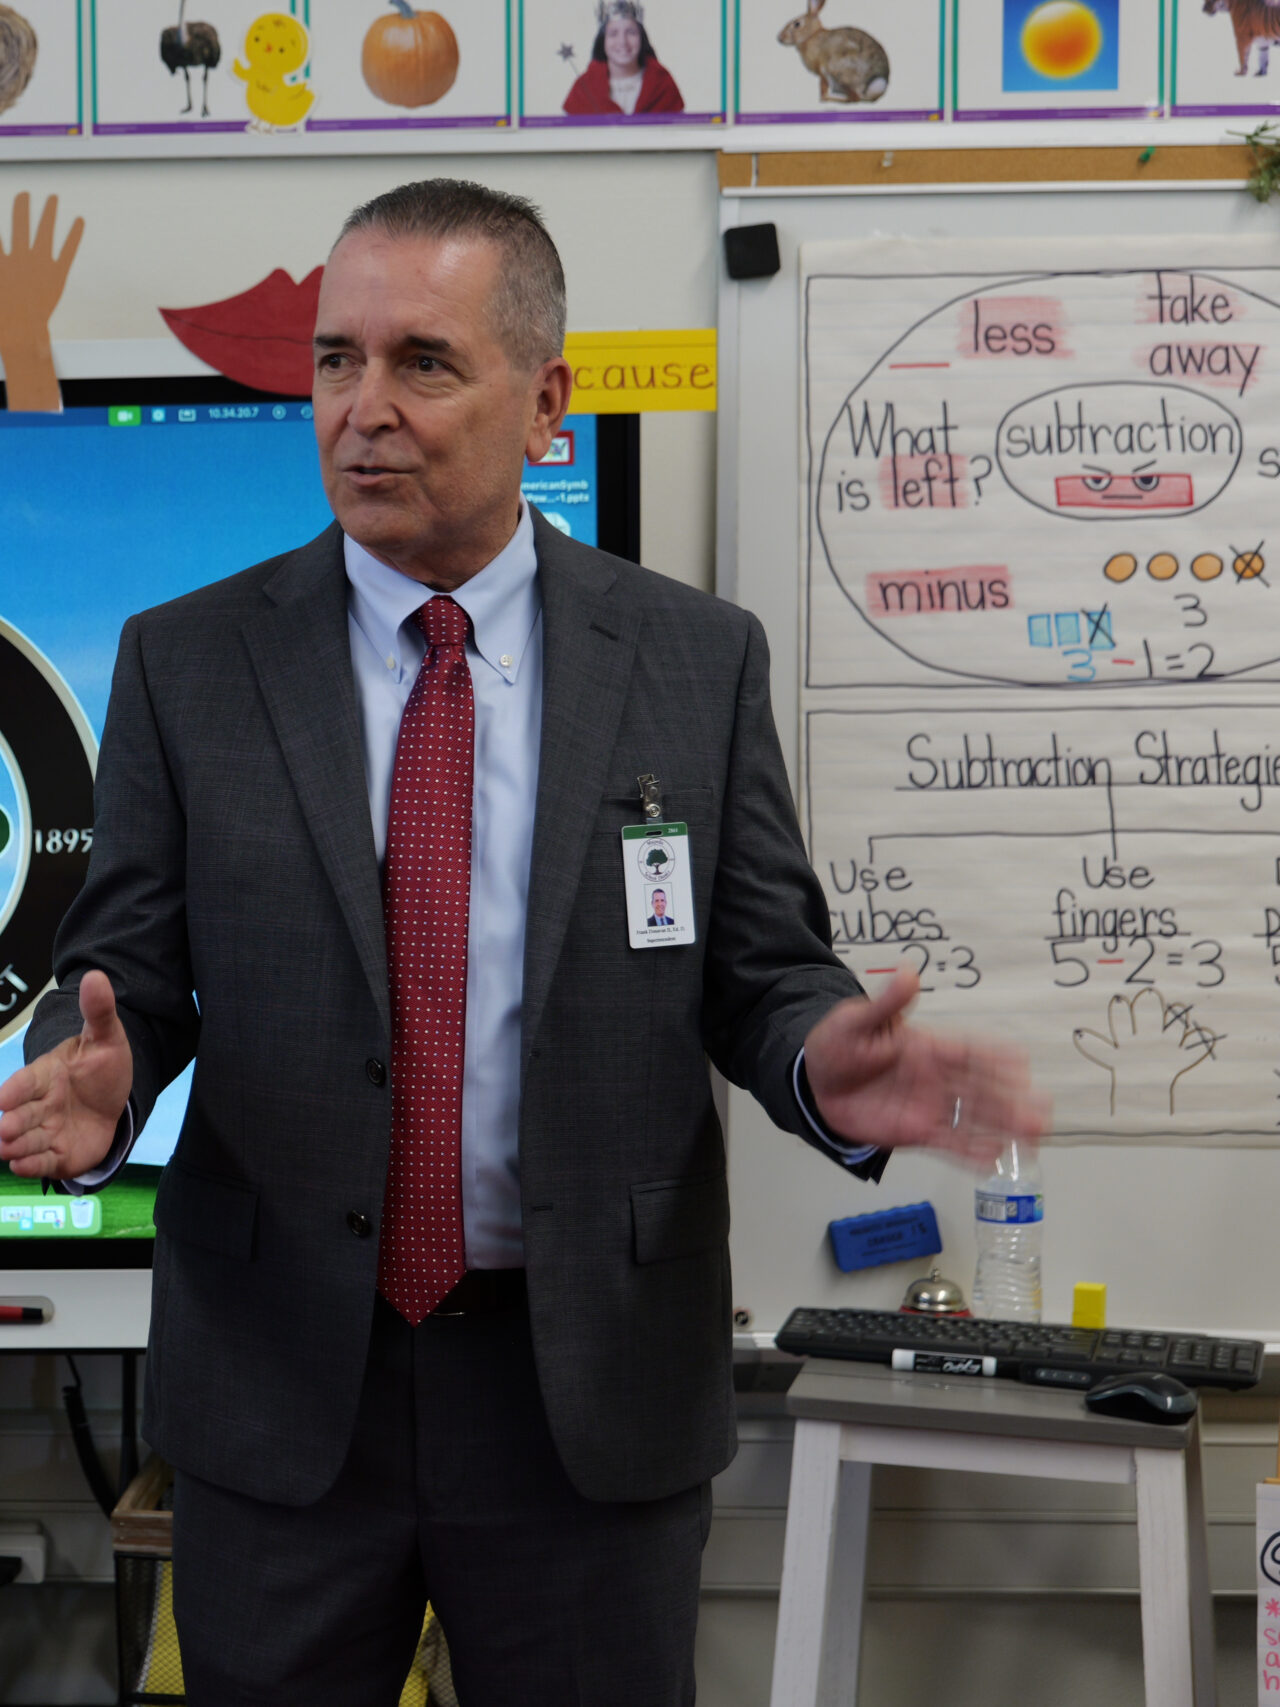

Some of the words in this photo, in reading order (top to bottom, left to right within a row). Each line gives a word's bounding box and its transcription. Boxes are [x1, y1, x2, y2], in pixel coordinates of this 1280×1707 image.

[1147, 271, 1234, 326] take
[973, 299, 1057, 356] less
[574, 363, 714, 391] cause
[1149, 342, 1261, 398] away
[846, 400, 959, 458] What
[1006, 397, 1236, 458] subtraction
[837, 470, 871, 512] is
[878, 571, 1011, 611] minus
[907, 732, 1112, 792] Subtraction
[34, 828, 94, 854] 1895
[830, 860, 914, 893] Use
[1082, 856, 1155, 889] Use
[1052, 888, 1179, 954] fingers
